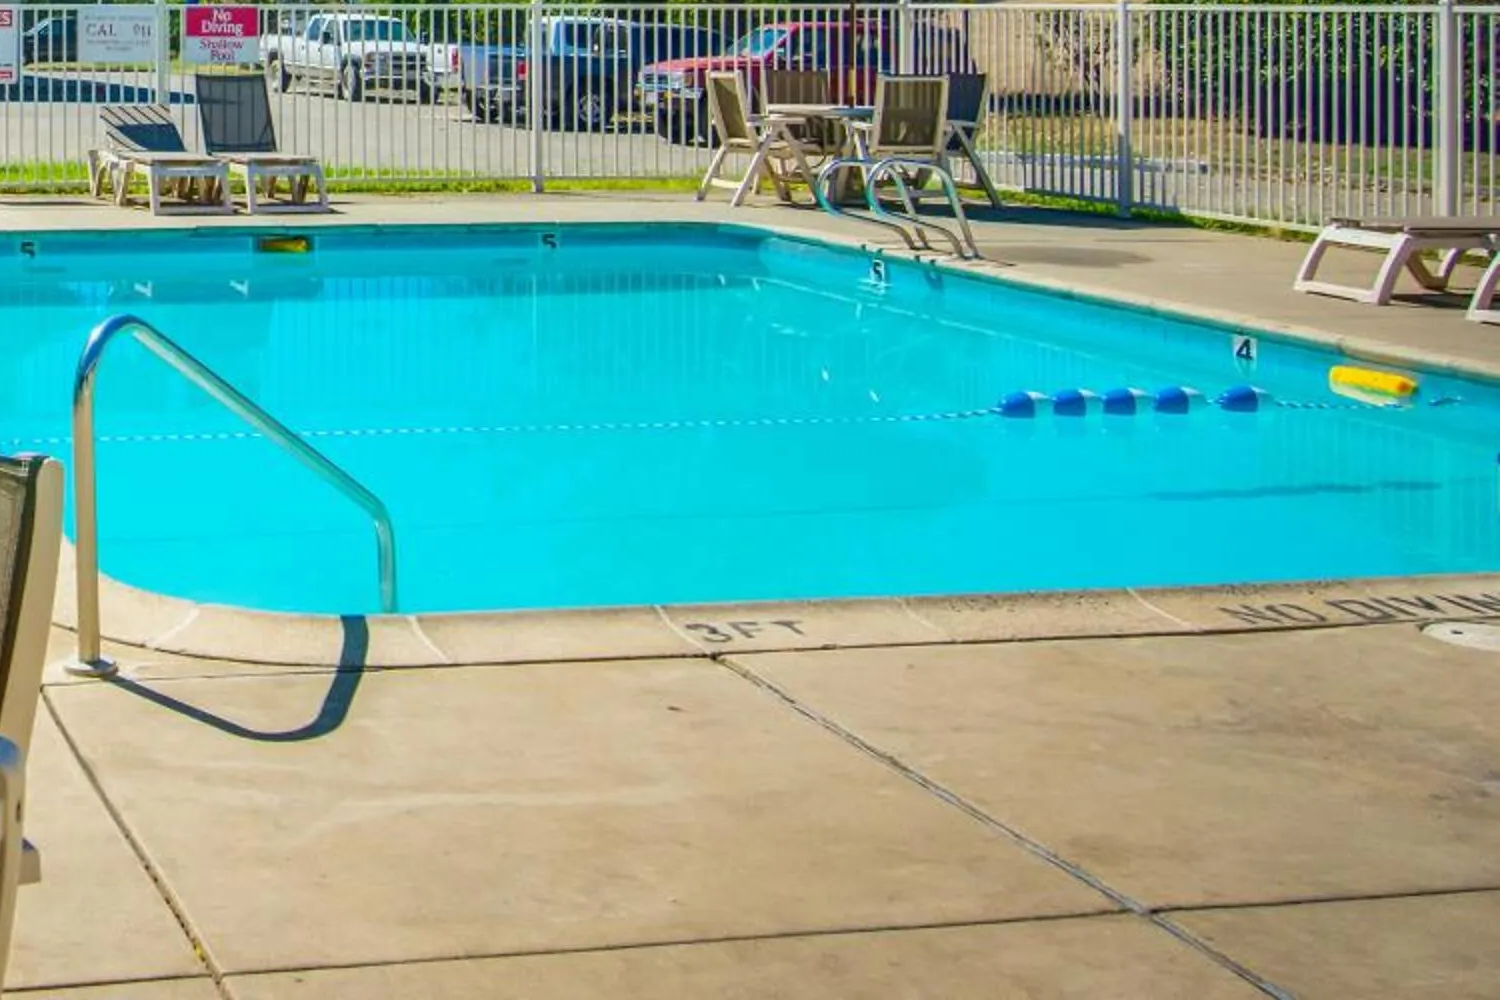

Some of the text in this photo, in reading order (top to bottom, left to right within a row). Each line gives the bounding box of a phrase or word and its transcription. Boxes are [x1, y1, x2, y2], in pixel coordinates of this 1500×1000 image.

[212, 8, 232, 22] No
[201, 20, 244, 37] Diving
[200, 38, 244, 50] Shallow
[210, 49, 236, 62] Pool
[1236, 338, 1254, 361] 4
[1219, 603, 1328, 625] NO
